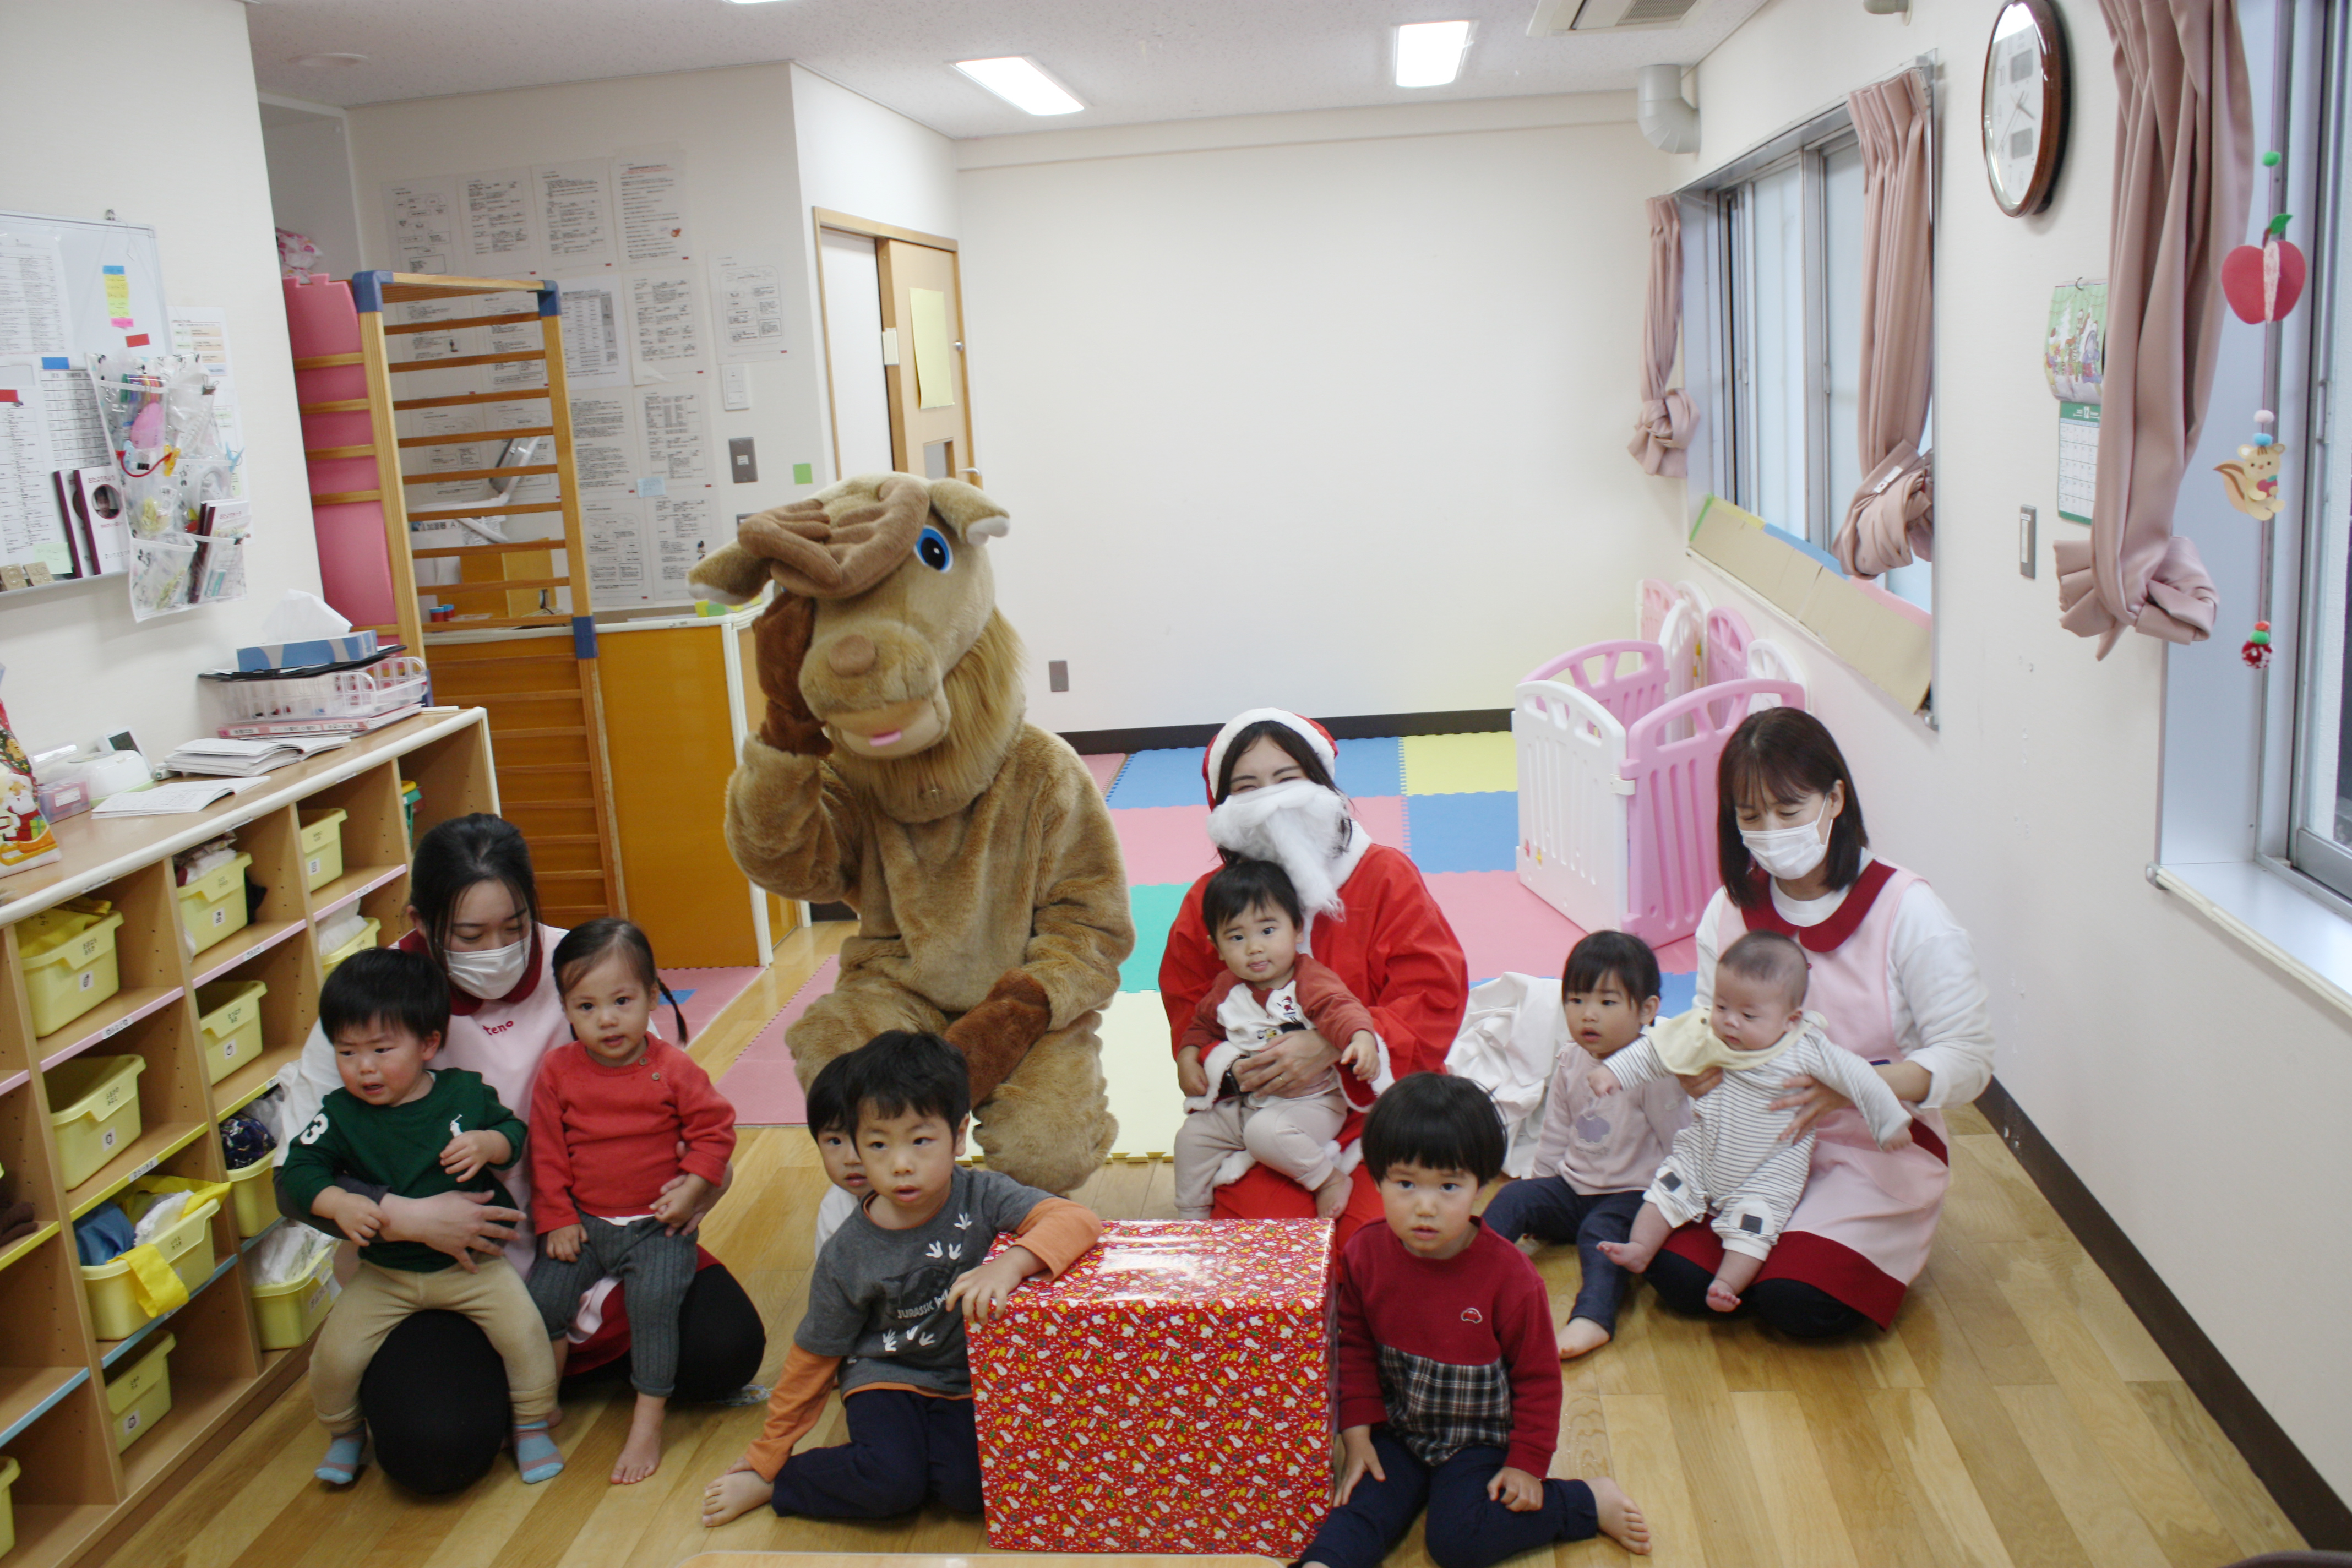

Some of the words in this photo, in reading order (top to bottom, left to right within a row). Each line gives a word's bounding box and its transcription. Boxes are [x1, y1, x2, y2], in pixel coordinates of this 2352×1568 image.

[482, 1020, 514, 1036] teno
[300, 1113, 329, 1145] 3
[897, 1300, 934, 1319] JURASSIC
